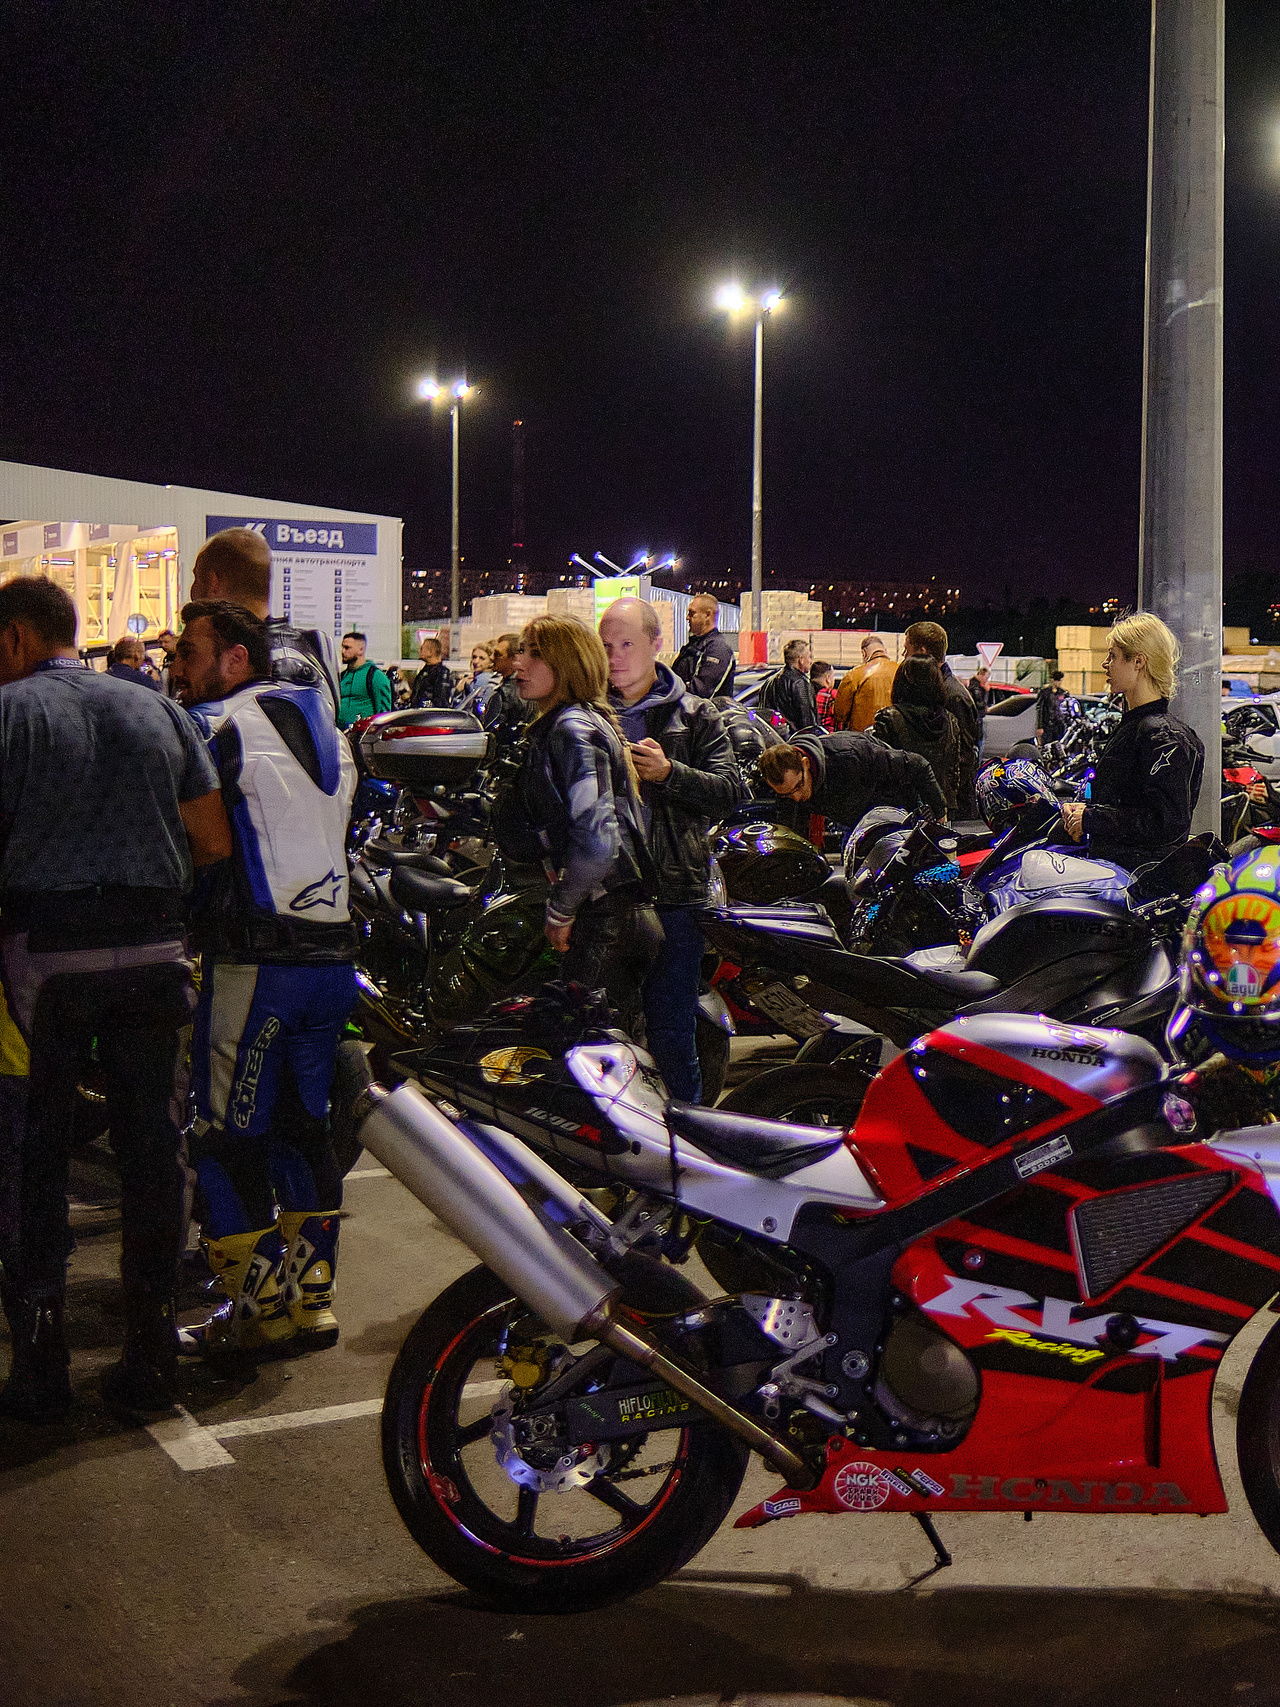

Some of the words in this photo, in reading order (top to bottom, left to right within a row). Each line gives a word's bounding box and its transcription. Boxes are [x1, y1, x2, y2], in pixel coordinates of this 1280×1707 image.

[276, 523, 345, 549] Въезд
[1030, 1047, 1107, 1068] HONDA
[984, 1327, 1107, 1366] Racing
[620, 1402, 690, 1424] RACING
[845, 1473, 880, 1487] NGK
[846, 1486, 879, 1495] SPARK
[914, 1470, 943, 1495] PEPSI
[948, 1473, 1193, 1508] HONDA
[773, 1500, 799, 1512] GAS
